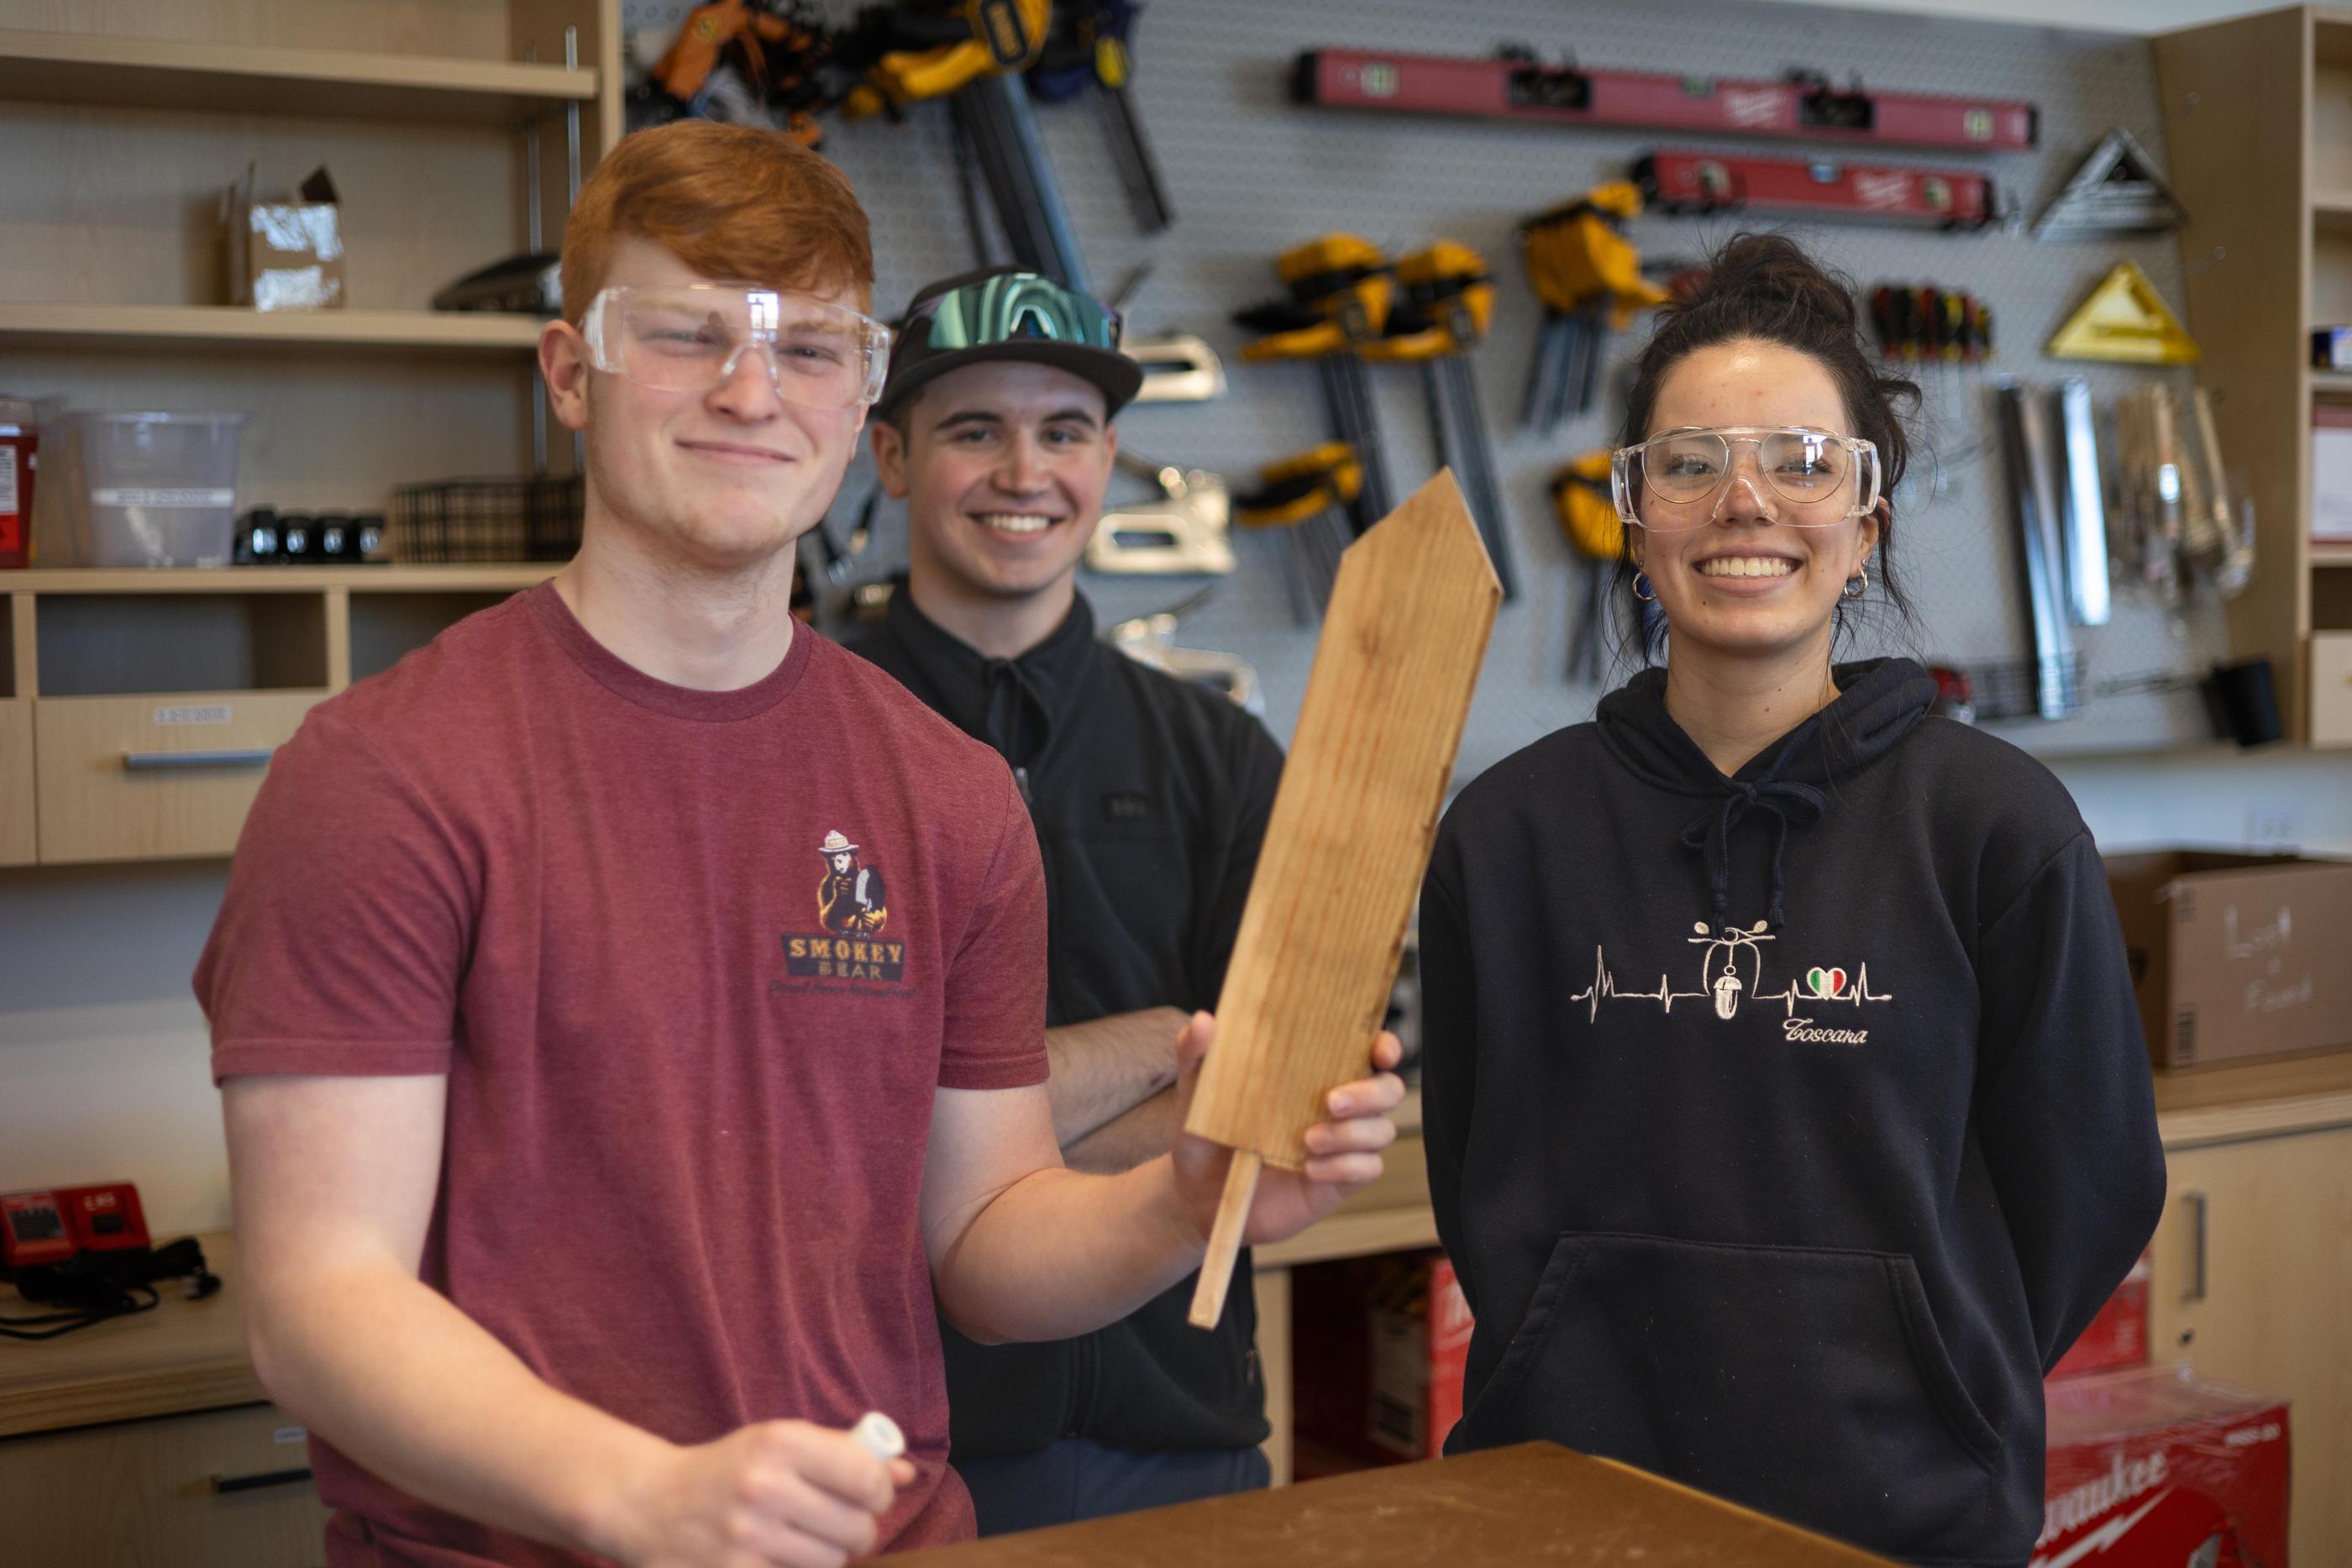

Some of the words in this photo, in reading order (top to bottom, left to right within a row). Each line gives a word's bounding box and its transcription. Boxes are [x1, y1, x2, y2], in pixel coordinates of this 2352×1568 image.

[789, 938, 903, 964] SMOKEY
[818, 961, 883, 980] BEAR
[1782, 1017, 1868, 1044] Toscana
[2034, 1450, 2170, 1549] waukee
